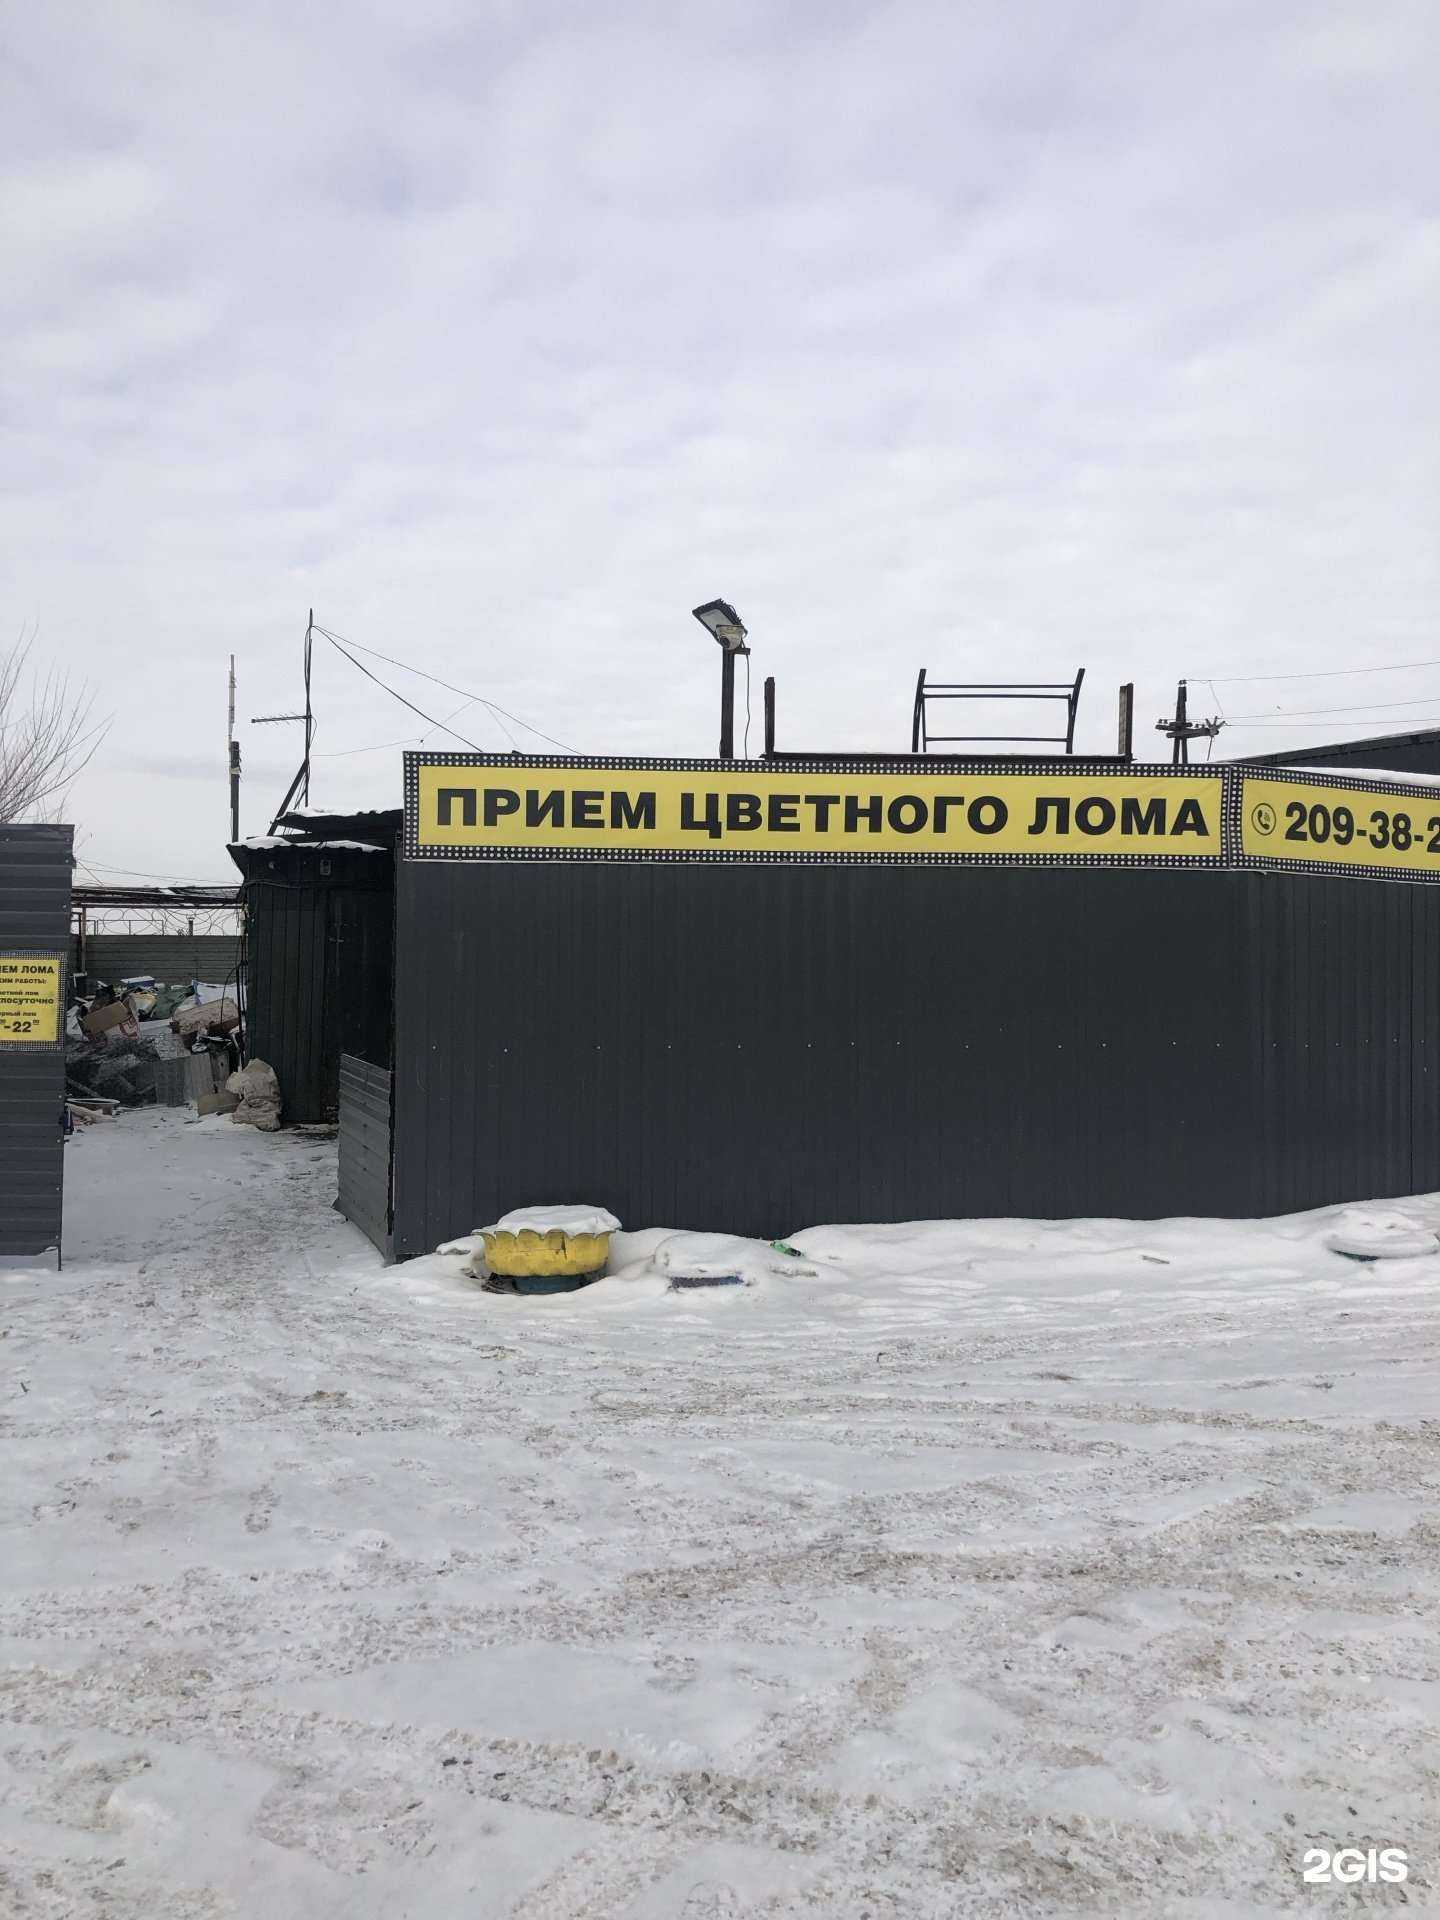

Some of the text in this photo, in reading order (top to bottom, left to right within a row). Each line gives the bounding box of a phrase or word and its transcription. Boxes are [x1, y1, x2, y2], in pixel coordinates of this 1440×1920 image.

[437, 788, 1210, 839] ПРИЕМ ЦВЕТНОГО ЛОМА
[0, 966, 54, 974] ЕМ ЛОМА
